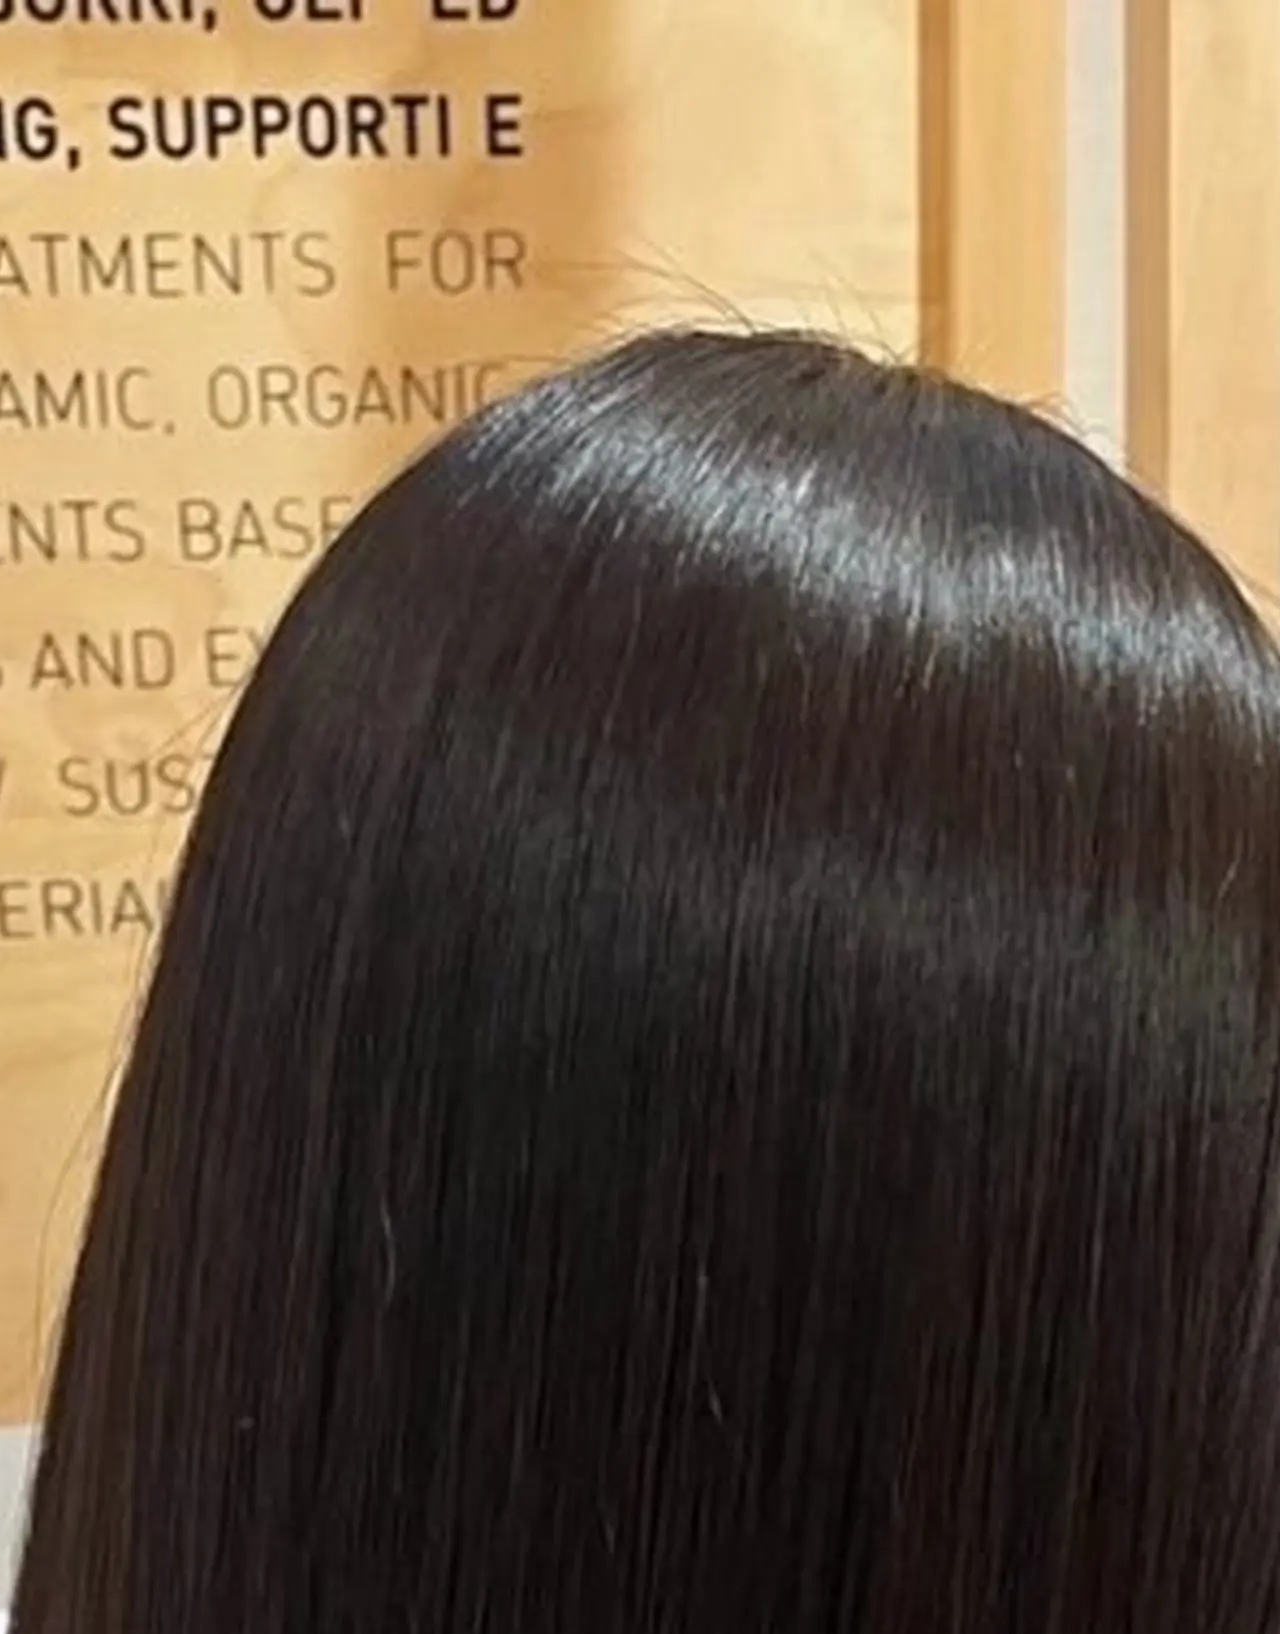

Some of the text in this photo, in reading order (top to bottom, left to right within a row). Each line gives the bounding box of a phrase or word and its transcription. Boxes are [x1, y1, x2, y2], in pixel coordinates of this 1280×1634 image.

[107, 94, 450, 160] SUPPORTI
[485, 94, 524, 158] E
[387, 230, 525, 294] FOR
[178, 496, 354, 563] BASE
[31, 629, 174, 689] AND
